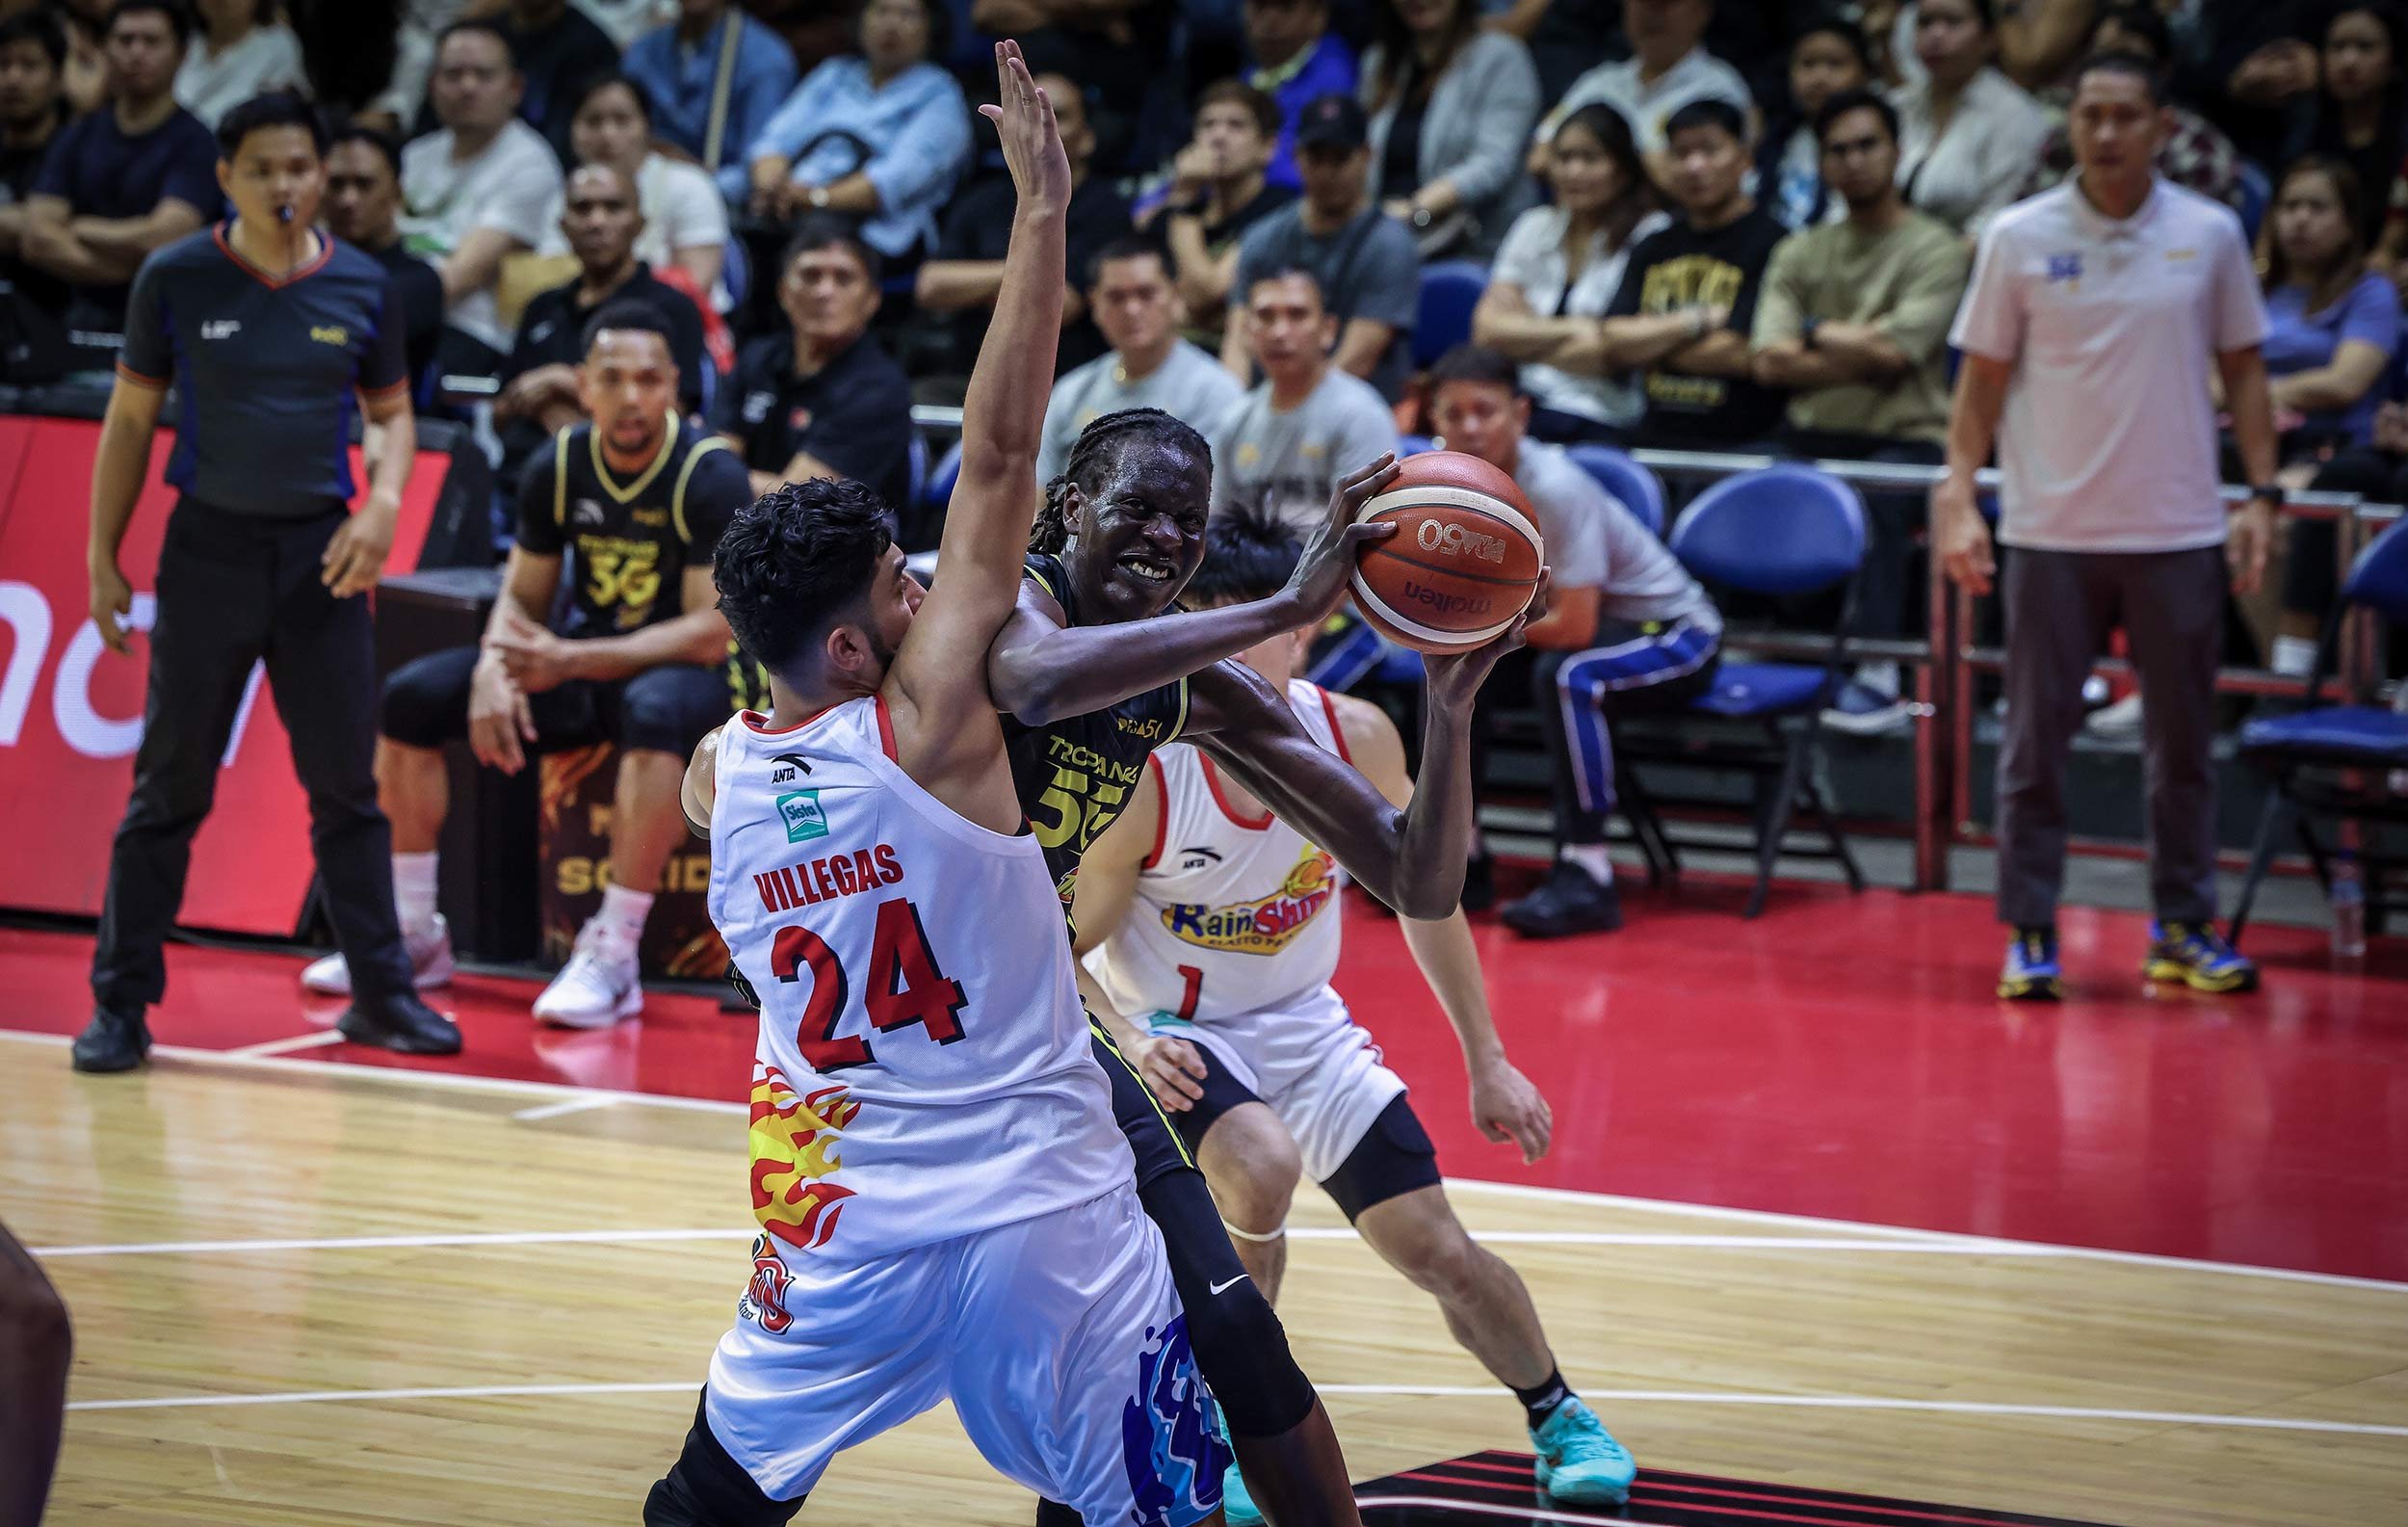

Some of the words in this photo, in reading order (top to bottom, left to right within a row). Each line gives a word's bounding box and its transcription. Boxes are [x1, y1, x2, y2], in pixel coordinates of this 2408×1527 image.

[1404, 581, 1492, 614] molten
[771, 766, 796, 784] ANTA
[785, 803, 818, 821] Sista
[753, 843, 904, 912] VILLEGAS
[771, 897, 969, 1074] 24
[1177, 963, 1203, 1021] 1
